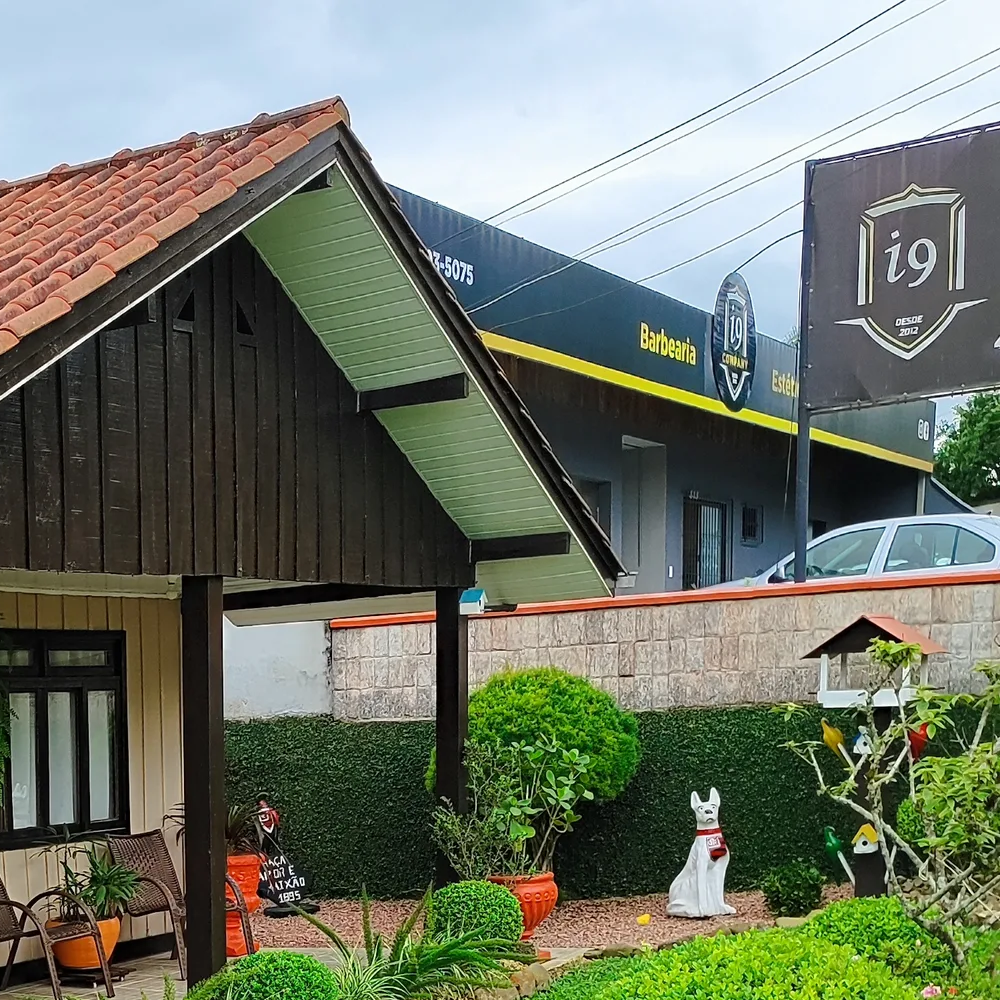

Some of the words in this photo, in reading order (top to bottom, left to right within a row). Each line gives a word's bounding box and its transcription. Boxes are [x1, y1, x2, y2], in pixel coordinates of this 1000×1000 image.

[885, 230, 937, 288] i9
[895, 315, 924, 327] DESDE
[898, 326, 919, 337] 2012
[640, 321, 696, 366] Barbearia
